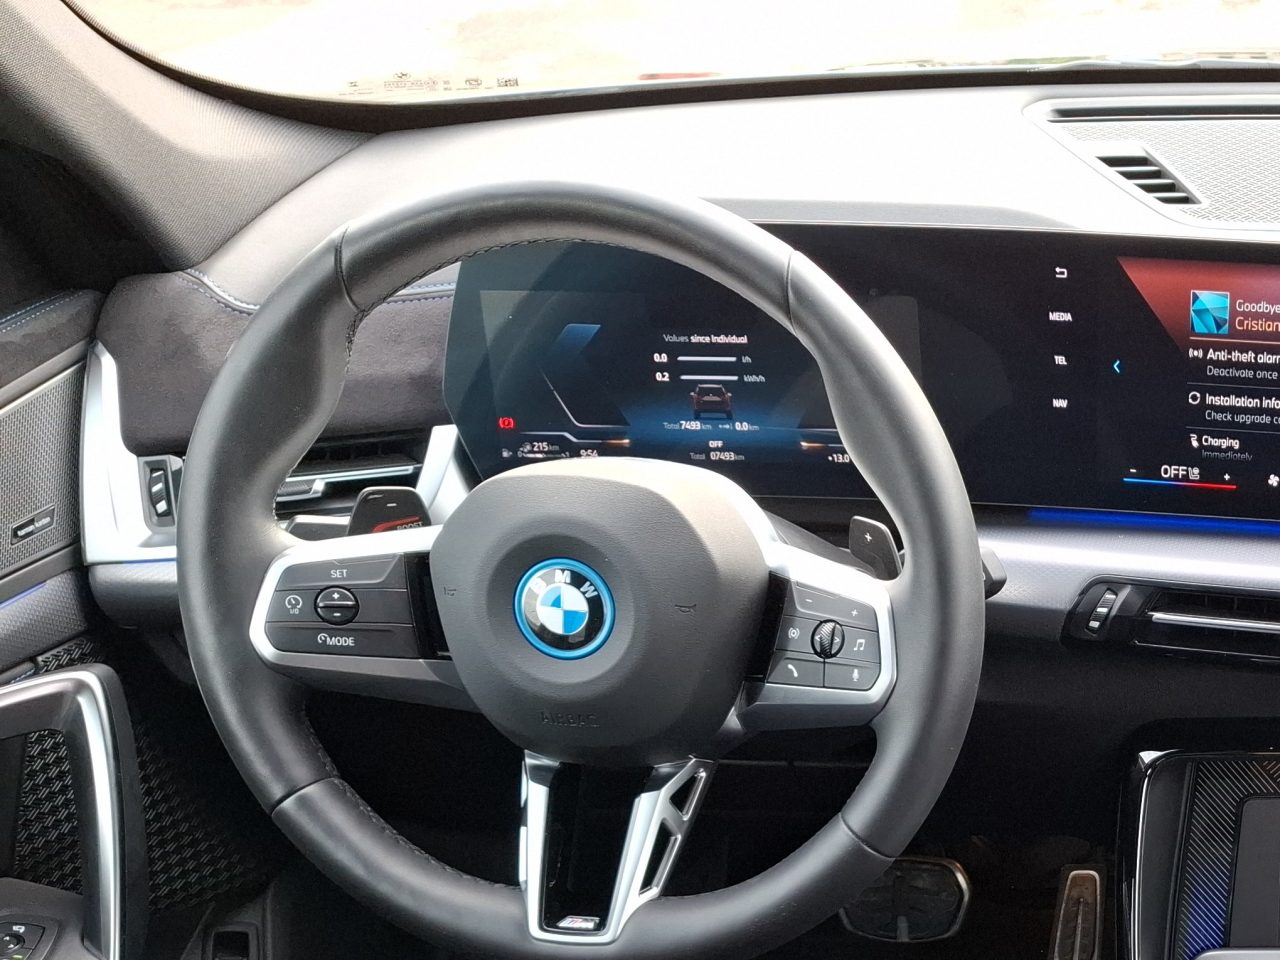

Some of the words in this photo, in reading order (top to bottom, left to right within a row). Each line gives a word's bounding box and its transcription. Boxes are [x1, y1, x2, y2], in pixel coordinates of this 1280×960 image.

[1048, 311, 1073, 322] MEDIA
[1235, 316, 1280, 332] Cristian
[663, 333, 689, 343] Values
[690, 334, 711, 344] since
[653, 352, 668, 363] 0.0
[1053, 355, 1068, 366] TEL
[1206, 347, 1256, 364] Anti-theft
[655, 371, 670, 382] 0.2
[1206, 365, 1254, 379] Deactivate
[1255, 370, 1279, 380] once
[1052, 398, 1068, 409] NAV
[1205, 393, 1260, 408] Installation
[1205, 409, 1233, 422] Check
[1234, 412, 1271, 425] upgrade
[663, 422, 679, 430] Total
[680, 420, 701, 431] 7493
[735, 421, 749, 431] 0.0
[749, 423, 760, 431] km
[532, 441, 549, 452] 215
[549, 443, 560, 452] km
[708, 440, 724, 449] OFF
[1202, 435, 1240, 449] Charging
[689, 452, 706, 460] Total
[709, 451, 735, 461] 07493
[1201, 449, 1252, 462] Immediately
[1160, 464, 1188, 479] OFF
[330, 569, 348, 578] SET
[326, 636, 356, 647] MODE
